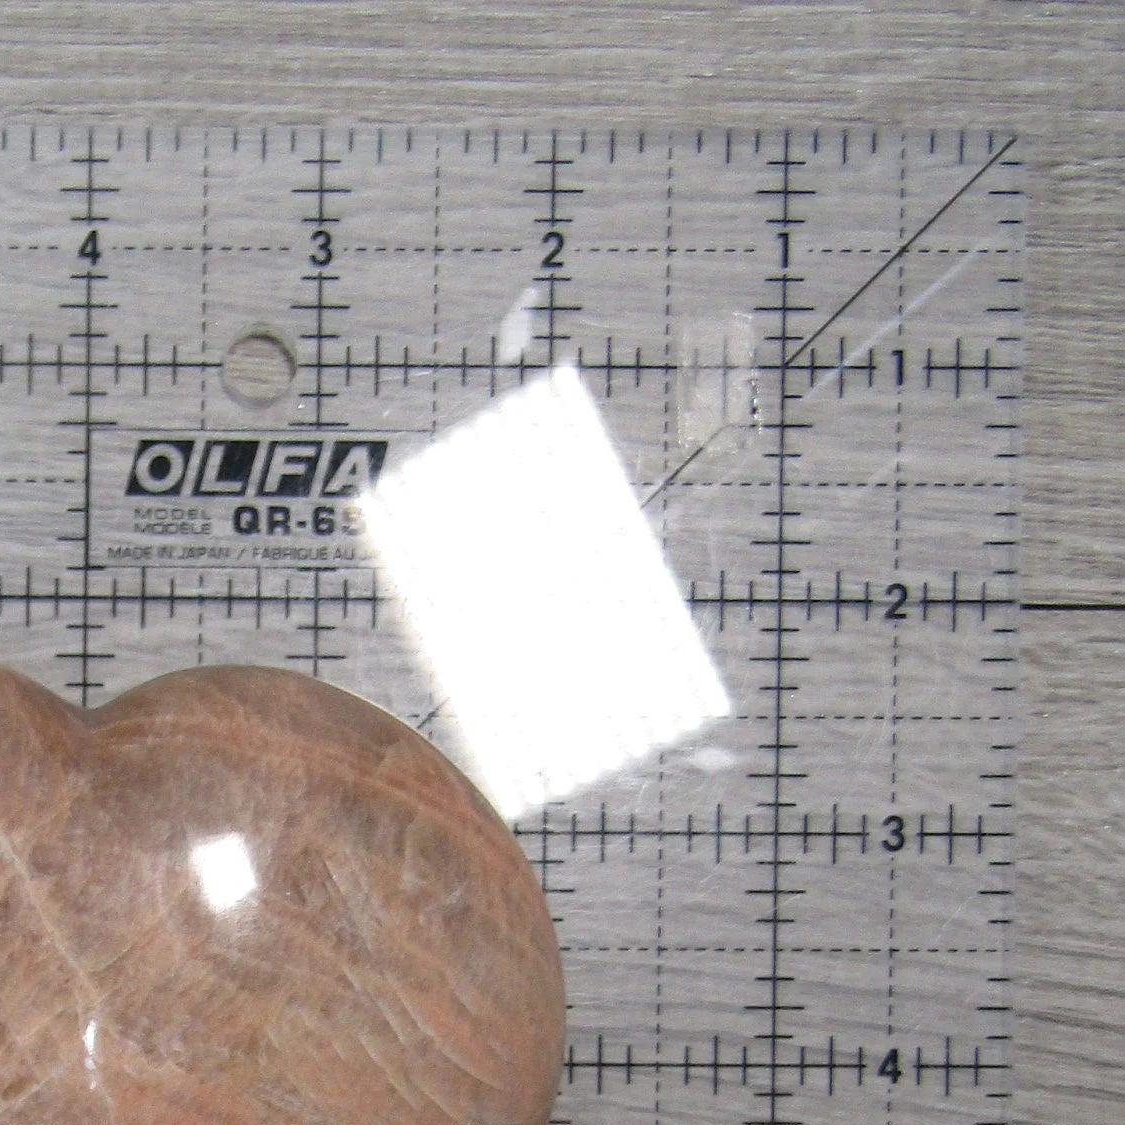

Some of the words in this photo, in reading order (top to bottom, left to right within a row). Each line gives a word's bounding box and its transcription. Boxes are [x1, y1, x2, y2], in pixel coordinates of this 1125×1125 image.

[78, 230, 102, 265] 4
[309, 230, 333, 266] 3
[541, 232, 565, 268] 2
[777, 233, 790, 268] 1
[892, 350, 904, 386] 1
[127, 440, 387, 497] OLFA
[134, 508, 211, 520] MODEL
[107, 546, 152, 559] MADE
[156, 546, 174, 559] IN
[178, 546, 230, 560] JAPAN
[252, 546, 328, 561] FABRIQUE
[885, 583, 908, 619] 2
[881, 815, 905, 852] 3
[878, 1048, 902, 1084] 4
